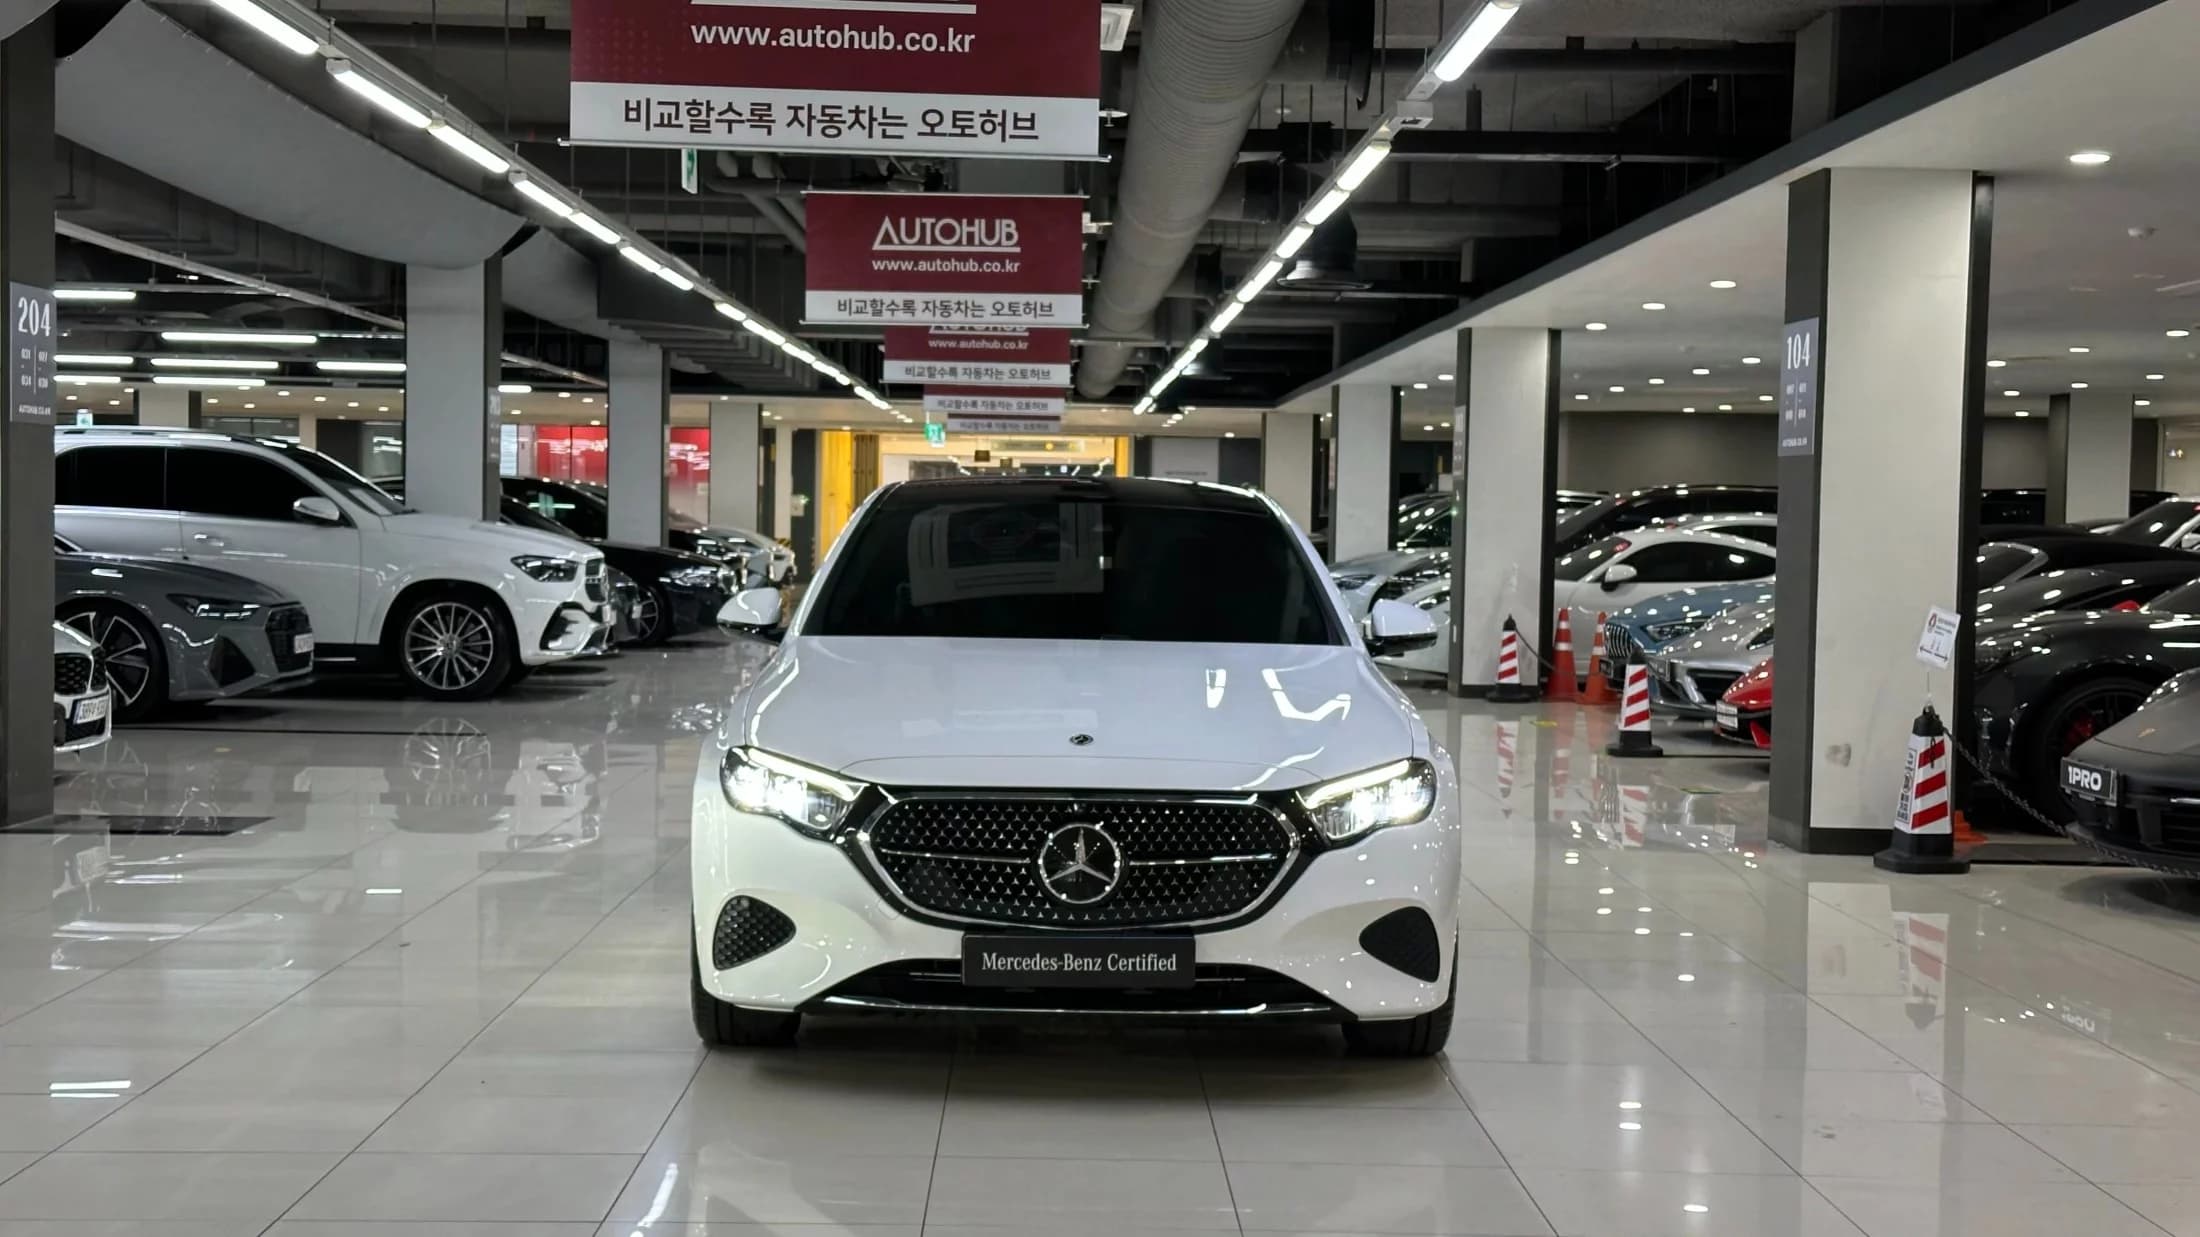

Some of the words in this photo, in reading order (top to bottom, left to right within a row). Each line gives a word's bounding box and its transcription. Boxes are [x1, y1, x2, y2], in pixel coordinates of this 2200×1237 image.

[690, 24, 976, 52] www.autohub.co.kr
[624, 98, 776, 136] 비교할수록
[786, 103, 908, 139] 자동차는
[917, 108, 1039, 143] 오토허브
[872, 216, 1020, 250] AUTOHUB
[872, 258, 1021, 272] www.autohub.co.kr
[18, 297, 51, 336] 204
[837, 298, 916, 318] 비교할수록
[922, 299, 985, 319] 자동차는
[990, 301, 1055, 319] 오토허브
[928, 339, 1029, 350] www.autohub.co.kr
[1787, 332, 1810, 370] 104
[905, 366, 958, 379] 비교할수록
[962, 367, 1004, 380] 자동차는
[1008, 369, 1051, 381] 오토허브
[2068, 765, 2102, 791] 1PRO
[981, 953, 1102, 971] Mercedes-Benz
[1107, 953, 1177, 971] Certified
